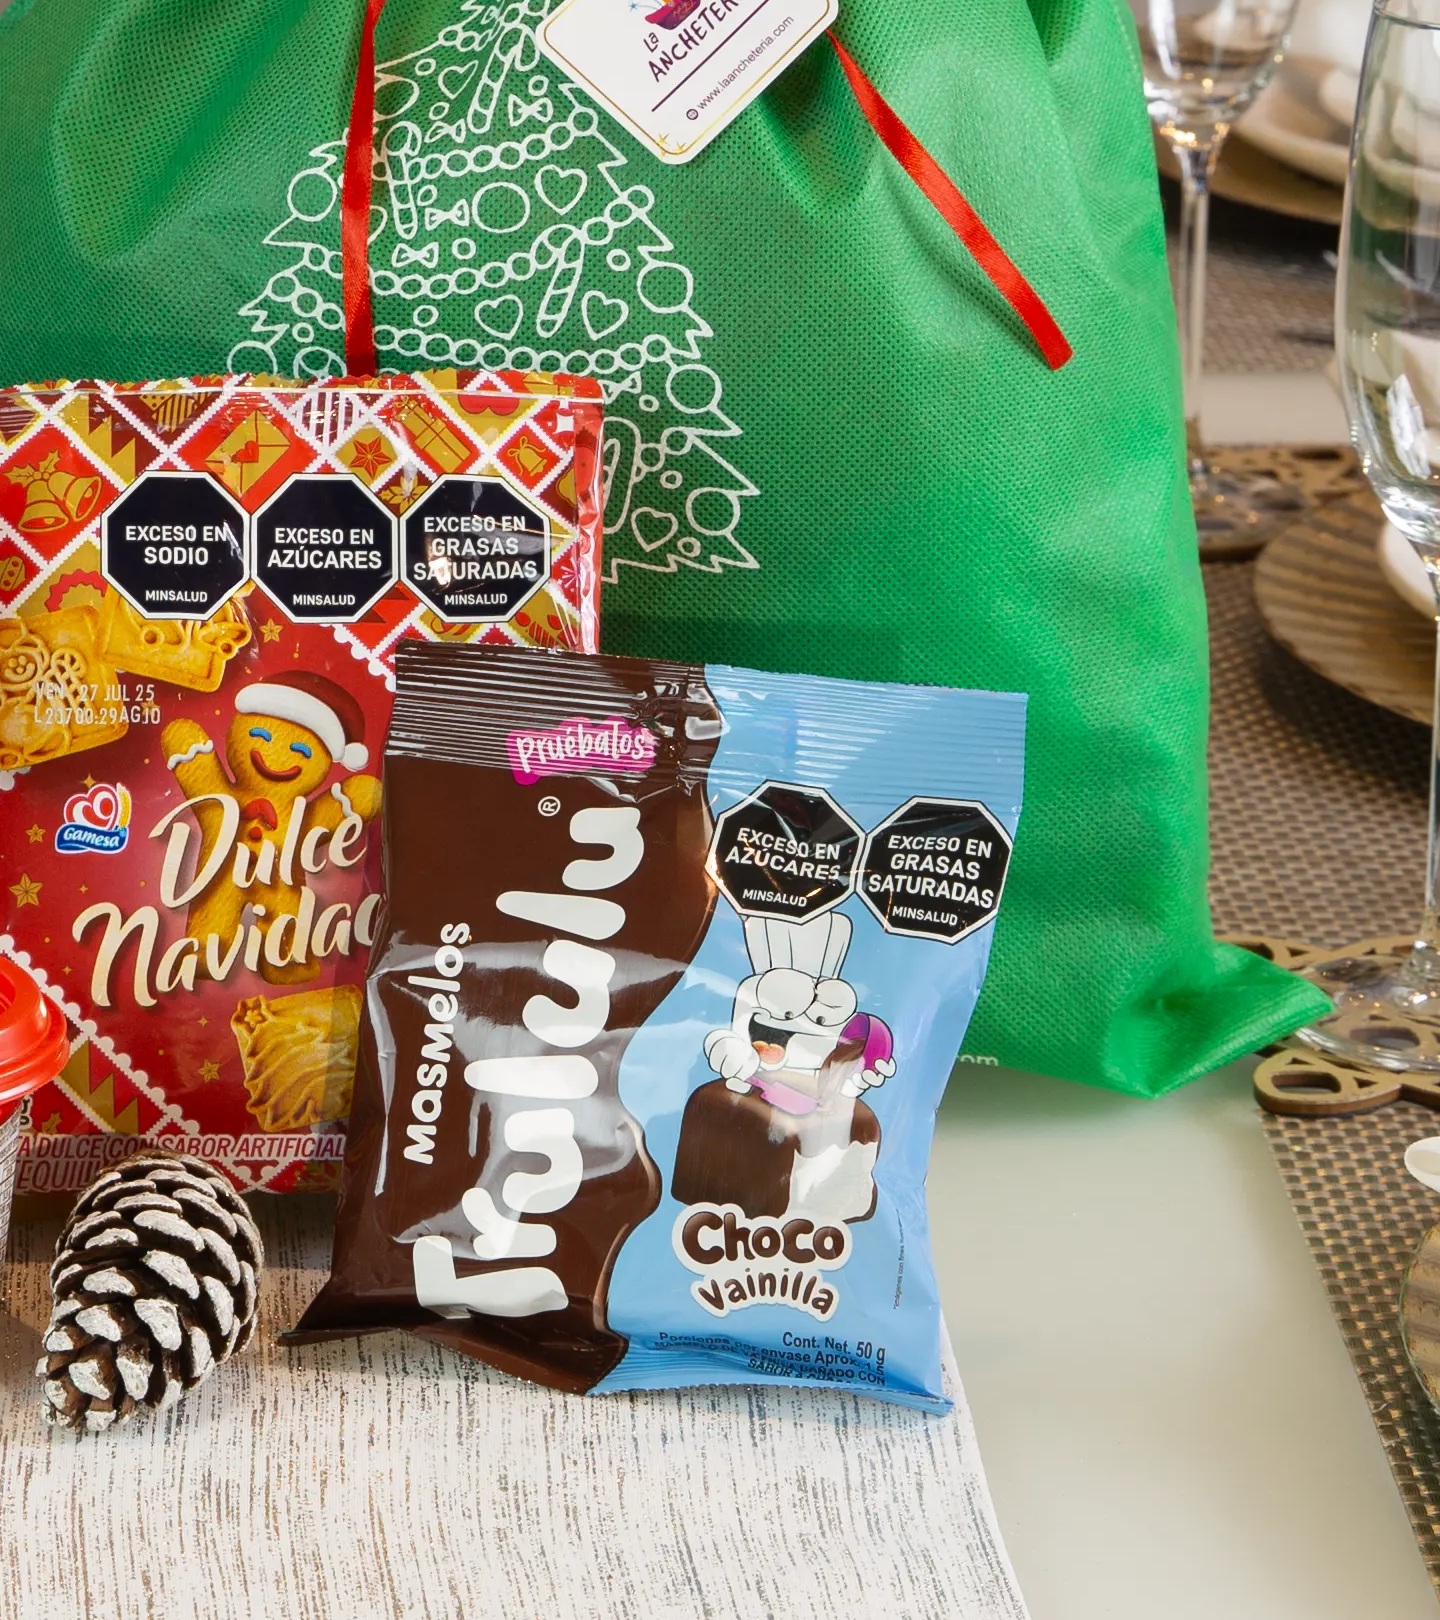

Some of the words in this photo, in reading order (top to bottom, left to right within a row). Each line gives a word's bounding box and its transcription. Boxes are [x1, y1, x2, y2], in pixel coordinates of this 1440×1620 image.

[642, 30, 661, 53] La
[697, 15, 795, 111] www.laancheteria.com
[125, 525, 198, 541] EXCESO
[203, 526, 227, 541] EN
[423, 516, 496, 532] EXCESO
[502, 516, 526, 532] EN
[274, 527, 344, 544] EXCESO
[350, 529, 374, 545] EN
[431, 537, 520, 557] GRASAS
[144, 546, 209, 565] SODIO
[267, 545, 382, 569] AZÚCARES
[413, 560, 538, 582] SATURADAS
[145, 590, 208, 602] MINSALUD
[293, 594, 356, 606] MINSALUD
[444, 593, 508, 605] MINSALUD
[79, 683, 98, 702] 27
[103, 684, 130, 702] JUL
[134, 684, 155, 702] 25
[63, 827, 120, 848] Gamesa
[736, 828, 810, 858] EXCESO
[815, 843, 841, 860] EN
[887, 835, 961, 851] EXCESO
[965, 839, 993, 858] EN
[148, 793, 368, 909] Dulce
[724, 845, 841, 881] AZÚCARES
[890, 854, 981, 880] GRASAS
[742, 888, 808, 907] MINSALUD
[868, 874, 995, 909] SATURADAS
[892, 905, 958, 926] MINSALUD
[412, 806, 644, 1318] Trululu
[36, 1136, 103, 1159] DULCE
[162, 1136, 236, 1158] SABOR
[237, 1136, 346, 1158] ARTIFICIAL
[659, 1331, 731, 1345] Porciones
[760, 1347, 811, 1363] envase
[814, 1350, 860, 1368] Aprox.
[782, 1331, 820, 1348] Cont.
[824, 1336, 852, 1355] Net.
[855, 1341, 872, 1359] 50
[876, 1347, 886, 1365] g
